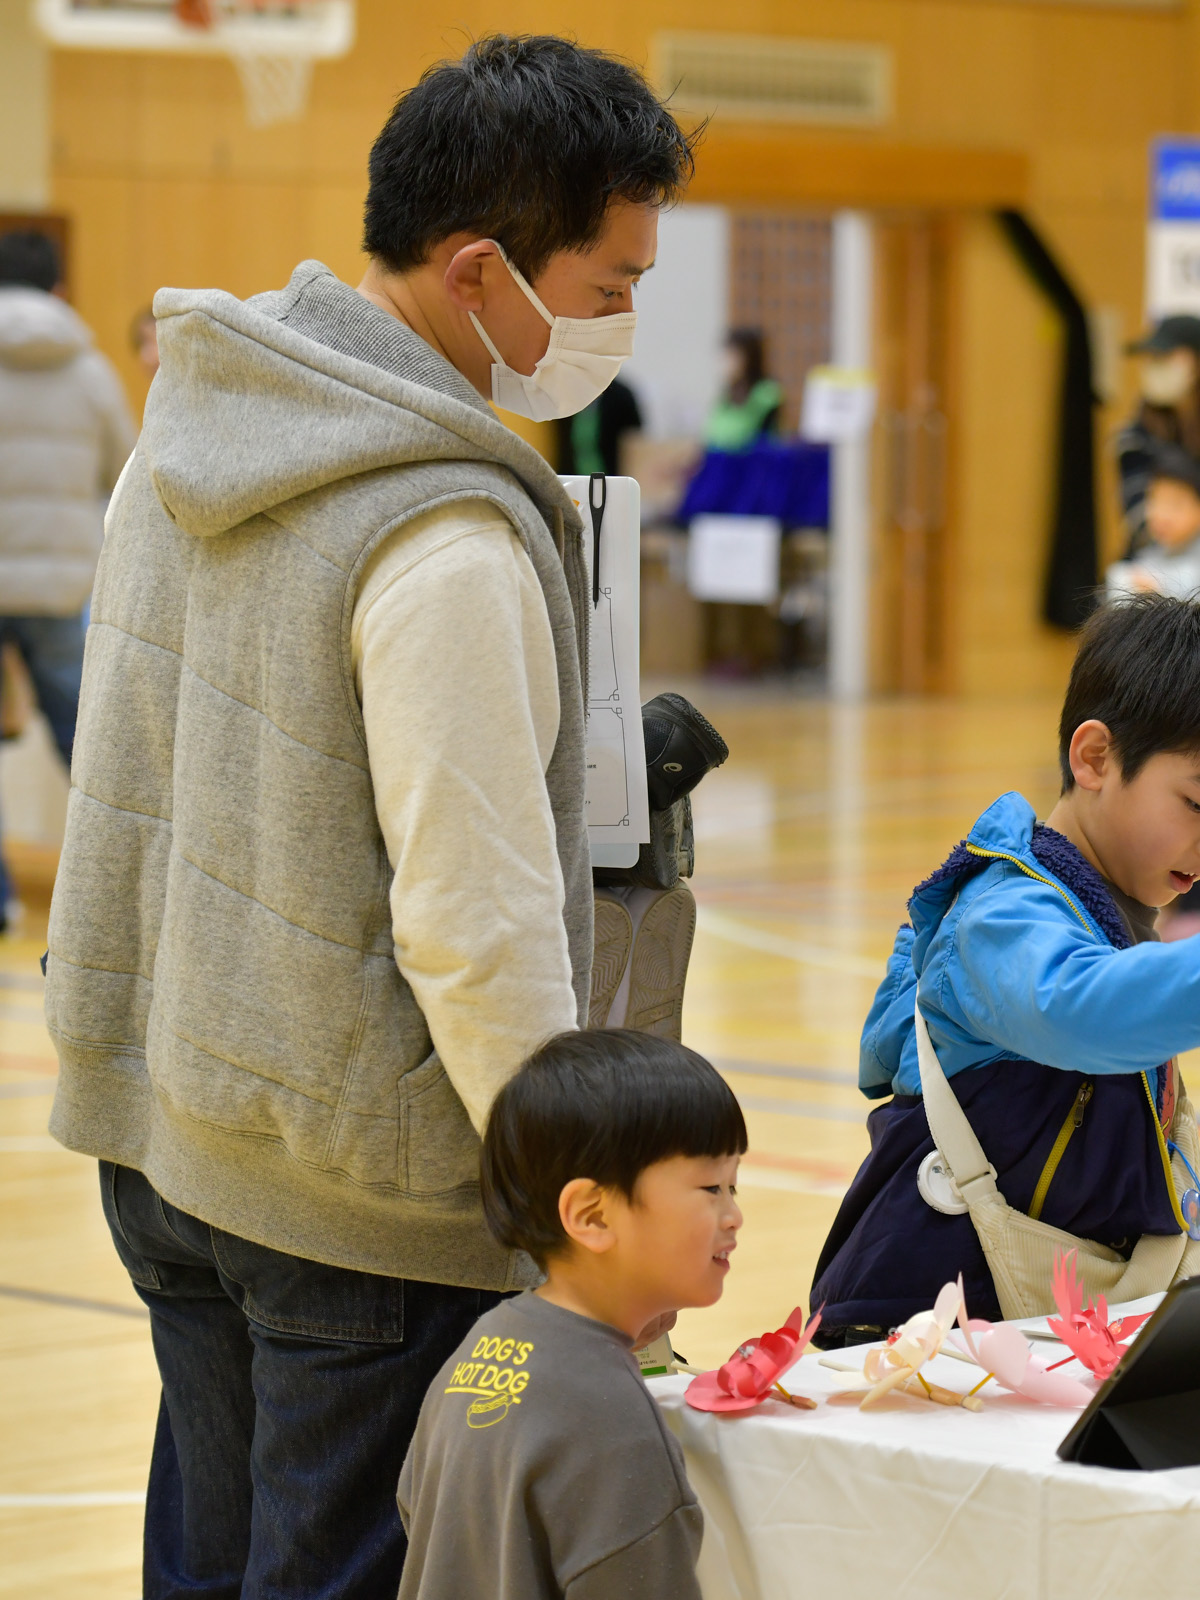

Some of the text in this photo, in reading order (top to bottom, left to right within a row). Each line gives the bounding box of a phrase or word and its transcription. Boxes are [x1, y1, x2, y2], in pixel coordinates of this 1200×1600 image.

[471, 1336, 534, 1365] DOG'S
[450, 1362, 530, 1394] HOT DOG
